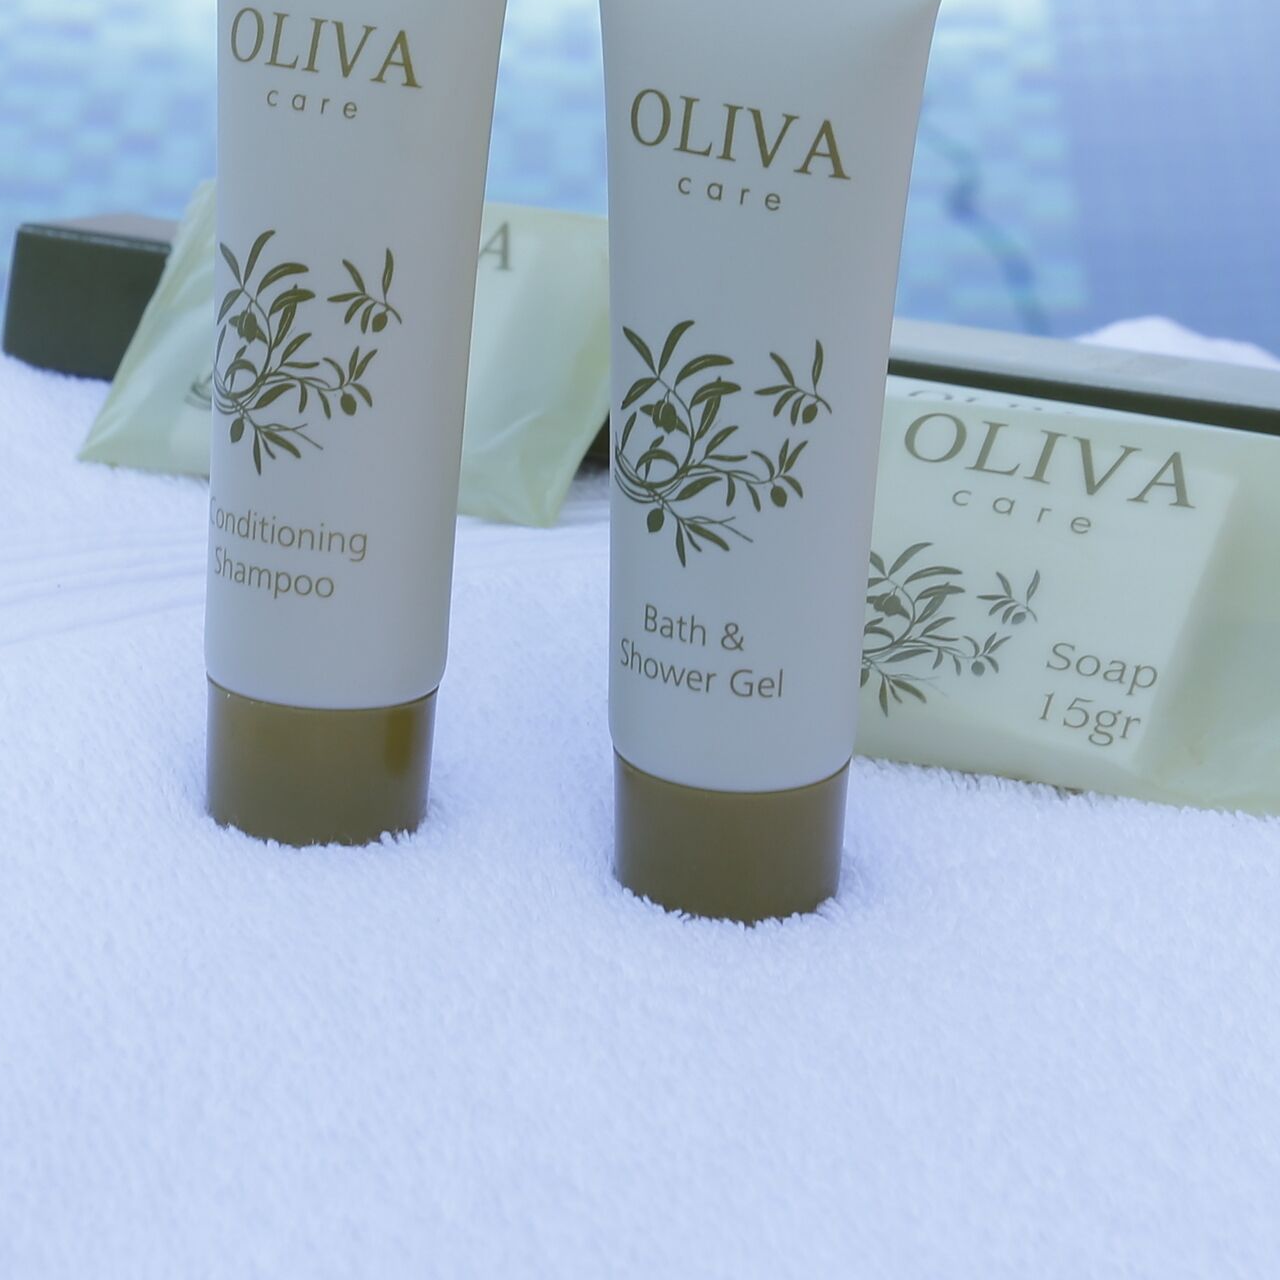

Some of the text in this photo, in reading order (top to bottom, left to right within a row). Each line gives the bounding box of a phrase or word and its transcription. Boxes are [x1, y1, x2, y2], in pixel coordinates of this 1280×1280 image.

[230, 6, 423, 89] OLIVA
[266, 89, 358, 120] care
[630, 88, 852, 181] OLIVA
[677, 176, 781, 212] care
[904, 412, 1197, 509] OLIVA
[209, 495, 368, 563] Conditioning
[951, 489, 1093, 535] care
[214, 545, 335, 600] Shampoo
[644, 603, 745, 652] Bath &
[620, 637, 785, 699] Shower Gel
[1045, 641, 1159, 697] Soap
[1039, 691, 1143, 748] 15gr
